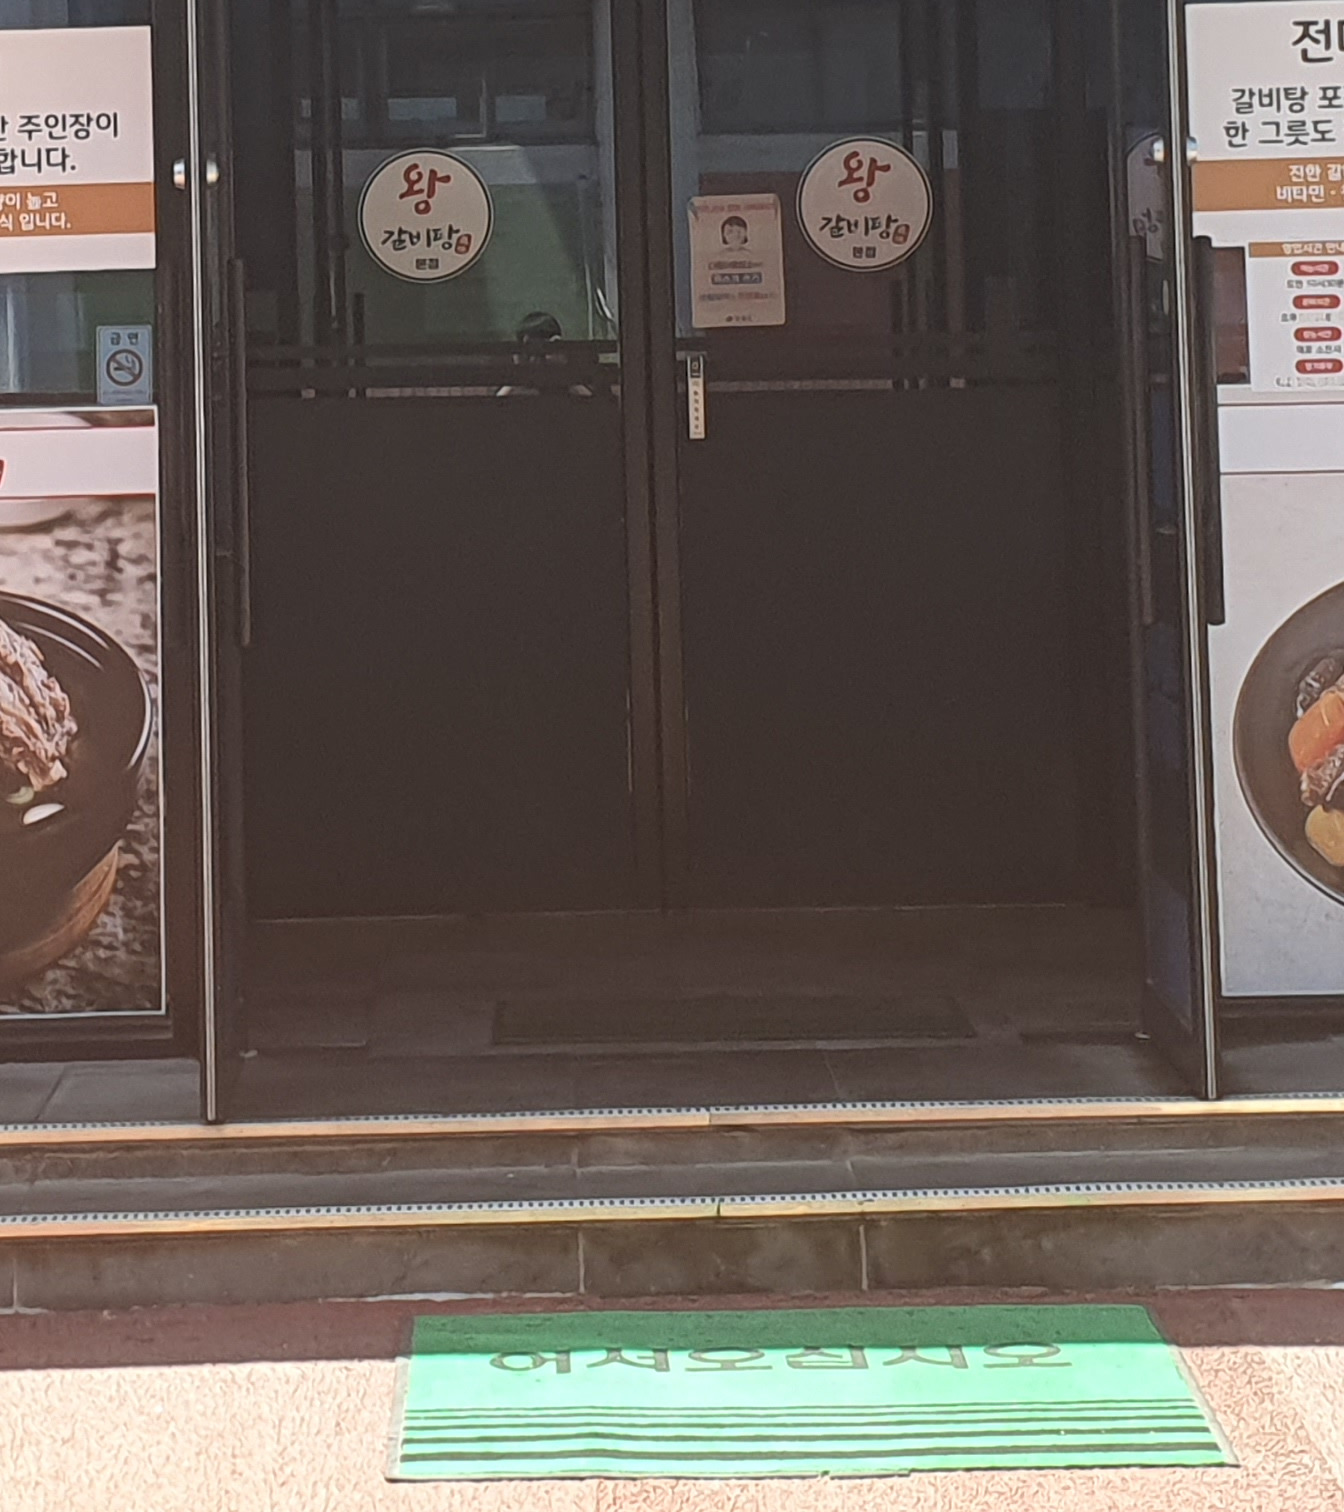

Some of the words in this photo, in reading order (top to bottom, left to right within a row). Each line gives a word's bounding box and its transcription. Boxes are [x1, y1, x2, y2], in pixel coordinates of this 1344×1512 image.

[1231, 86, 1307, 114] 갈비탕
[17, 112, 118, 139] 주인장이
[1224, 120, 1249, 148] 한
[1259, 118, 1336, 145] 그릇도
[837, 150, 891, 203] 왕
[1289, 164, 1320, 182] 진한
[27, 192, 58, 210] 높고
[399, 163, 451, 215] 왕
[1276, 185, 1324, 203] 비타민
[19, 211, 70, 230] 입니다.
[819, 214, 899, 240] 갈비탕
[381, 224, 460, 252] 갈비탕
[489, 1341, 1074, 1375] 어서오십시오
